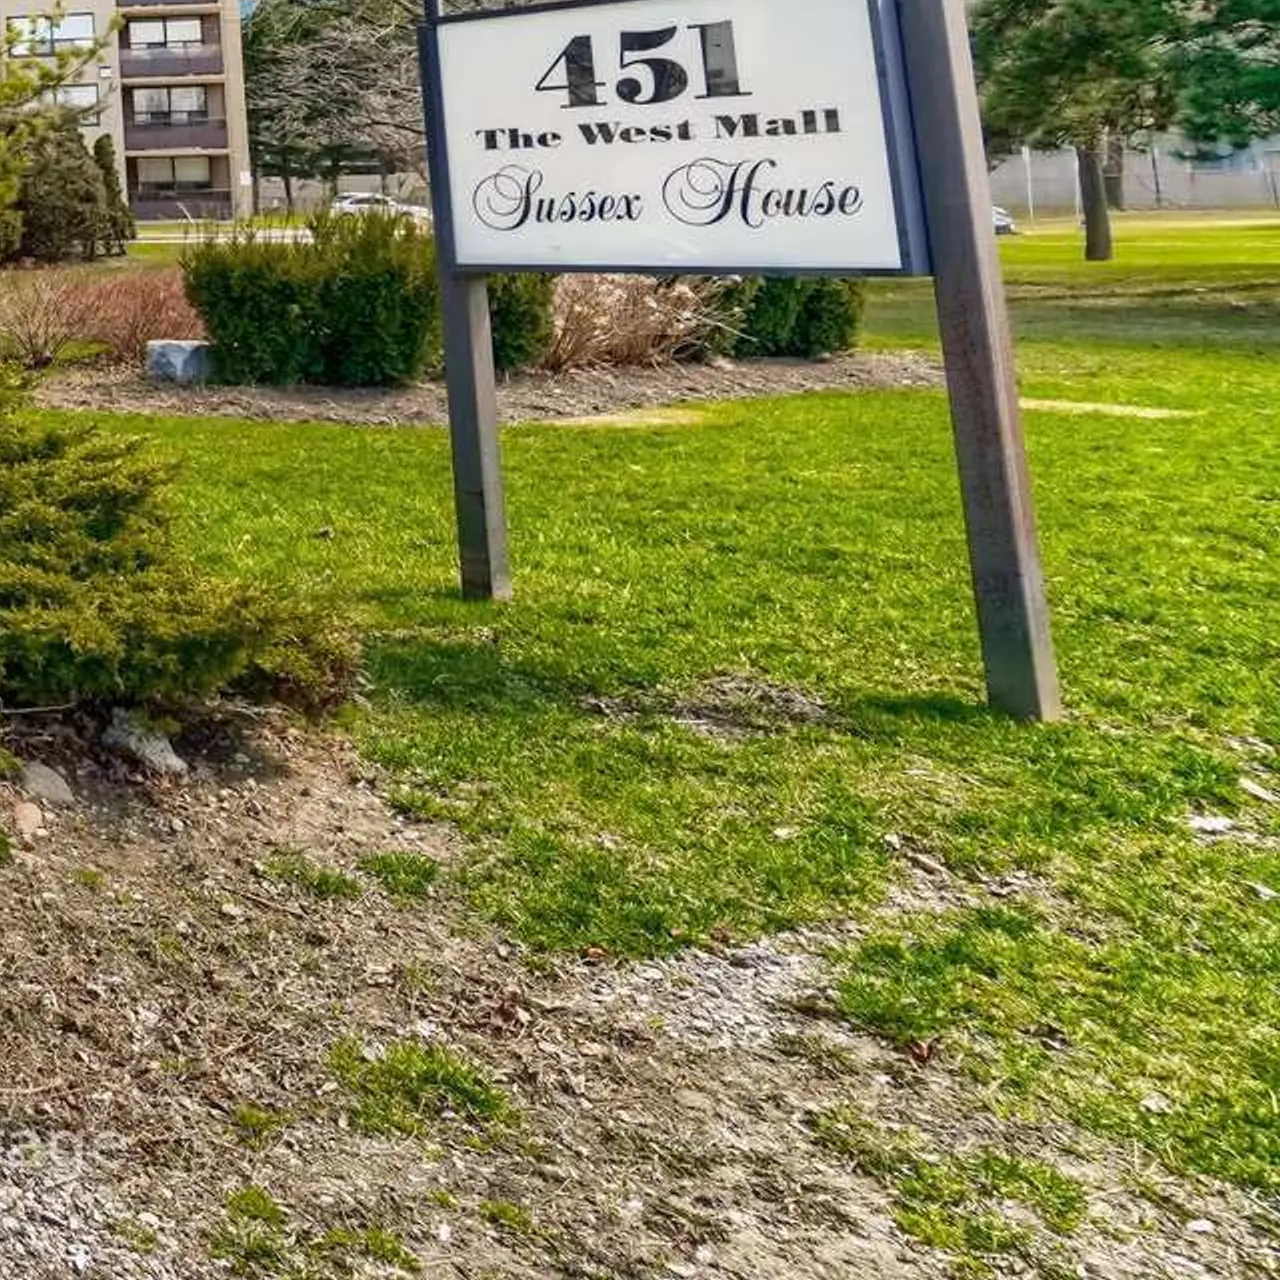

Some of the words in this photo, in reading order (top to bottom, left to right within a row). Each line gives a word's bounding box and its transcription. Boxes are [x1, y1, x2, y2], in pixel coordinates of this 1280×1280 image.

[534, 20, 753, 109] 451
[474, 127, 563, 151] The
[578, 119, 693, 146] West
[714, 108, 842, 139] Mall
[472, 164, 643, 232] Sussex
[661, 157, 863, 229] House
